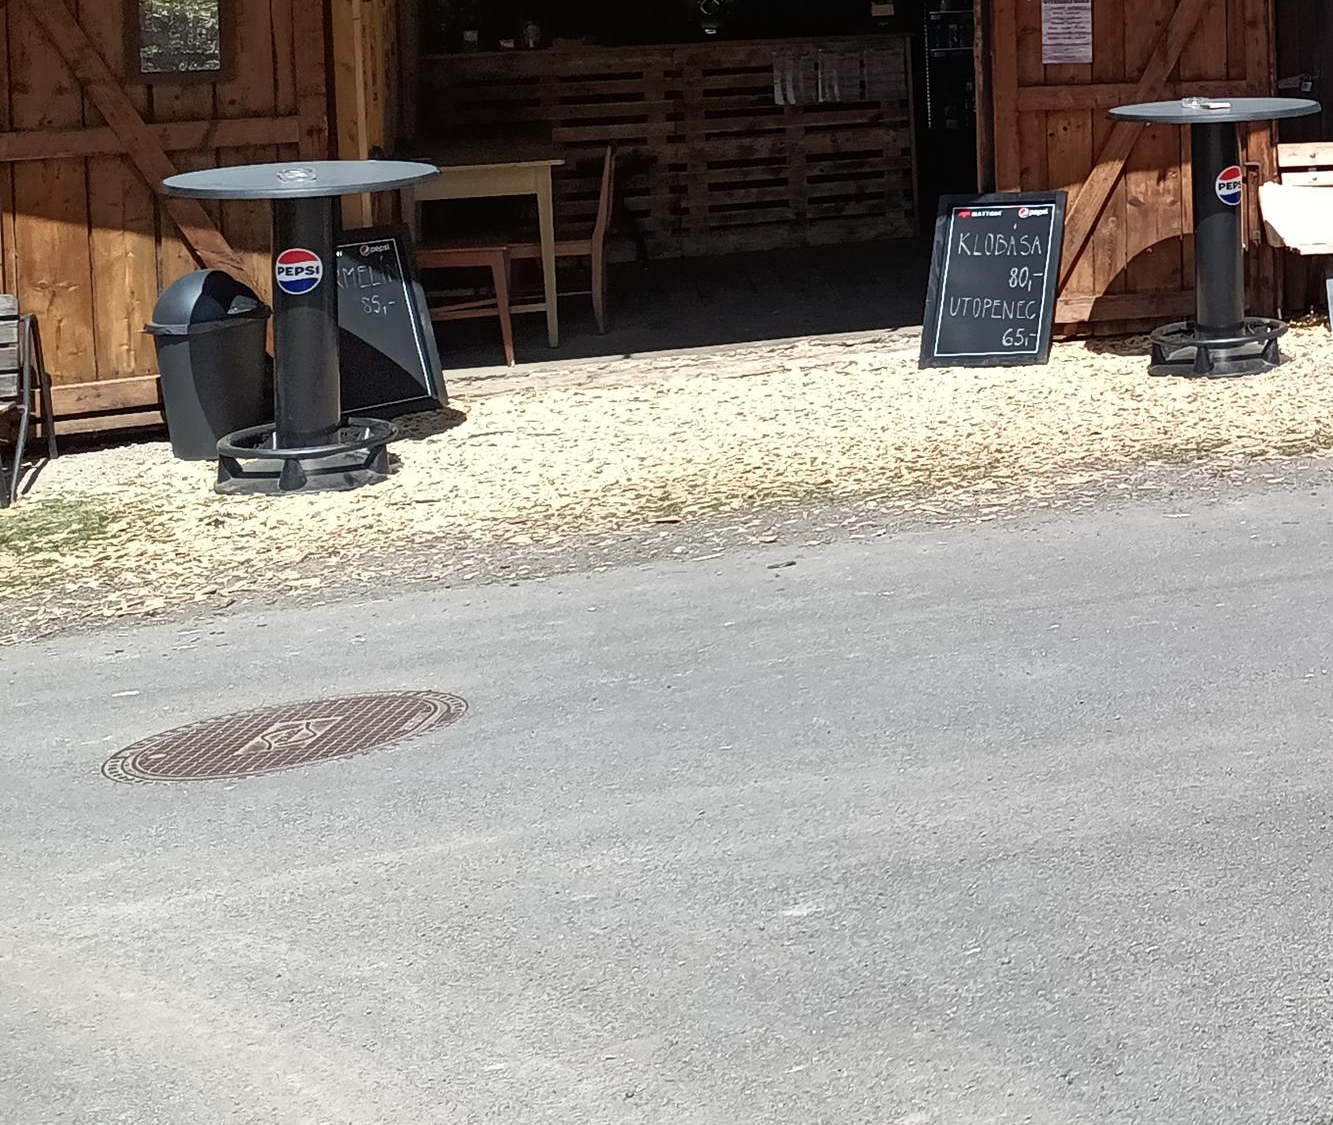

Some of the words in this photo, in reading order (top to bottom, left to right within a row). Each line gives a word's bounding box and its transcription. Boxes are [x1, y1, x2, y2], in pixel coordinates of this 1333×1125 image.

[277, 265, 321, 277] PEPSI
[1009, 267, 1044, 292] 80,-
[949, 297, 1036, 319] UTOPENEC
[1001, 328, 1038, 348] 65,-
